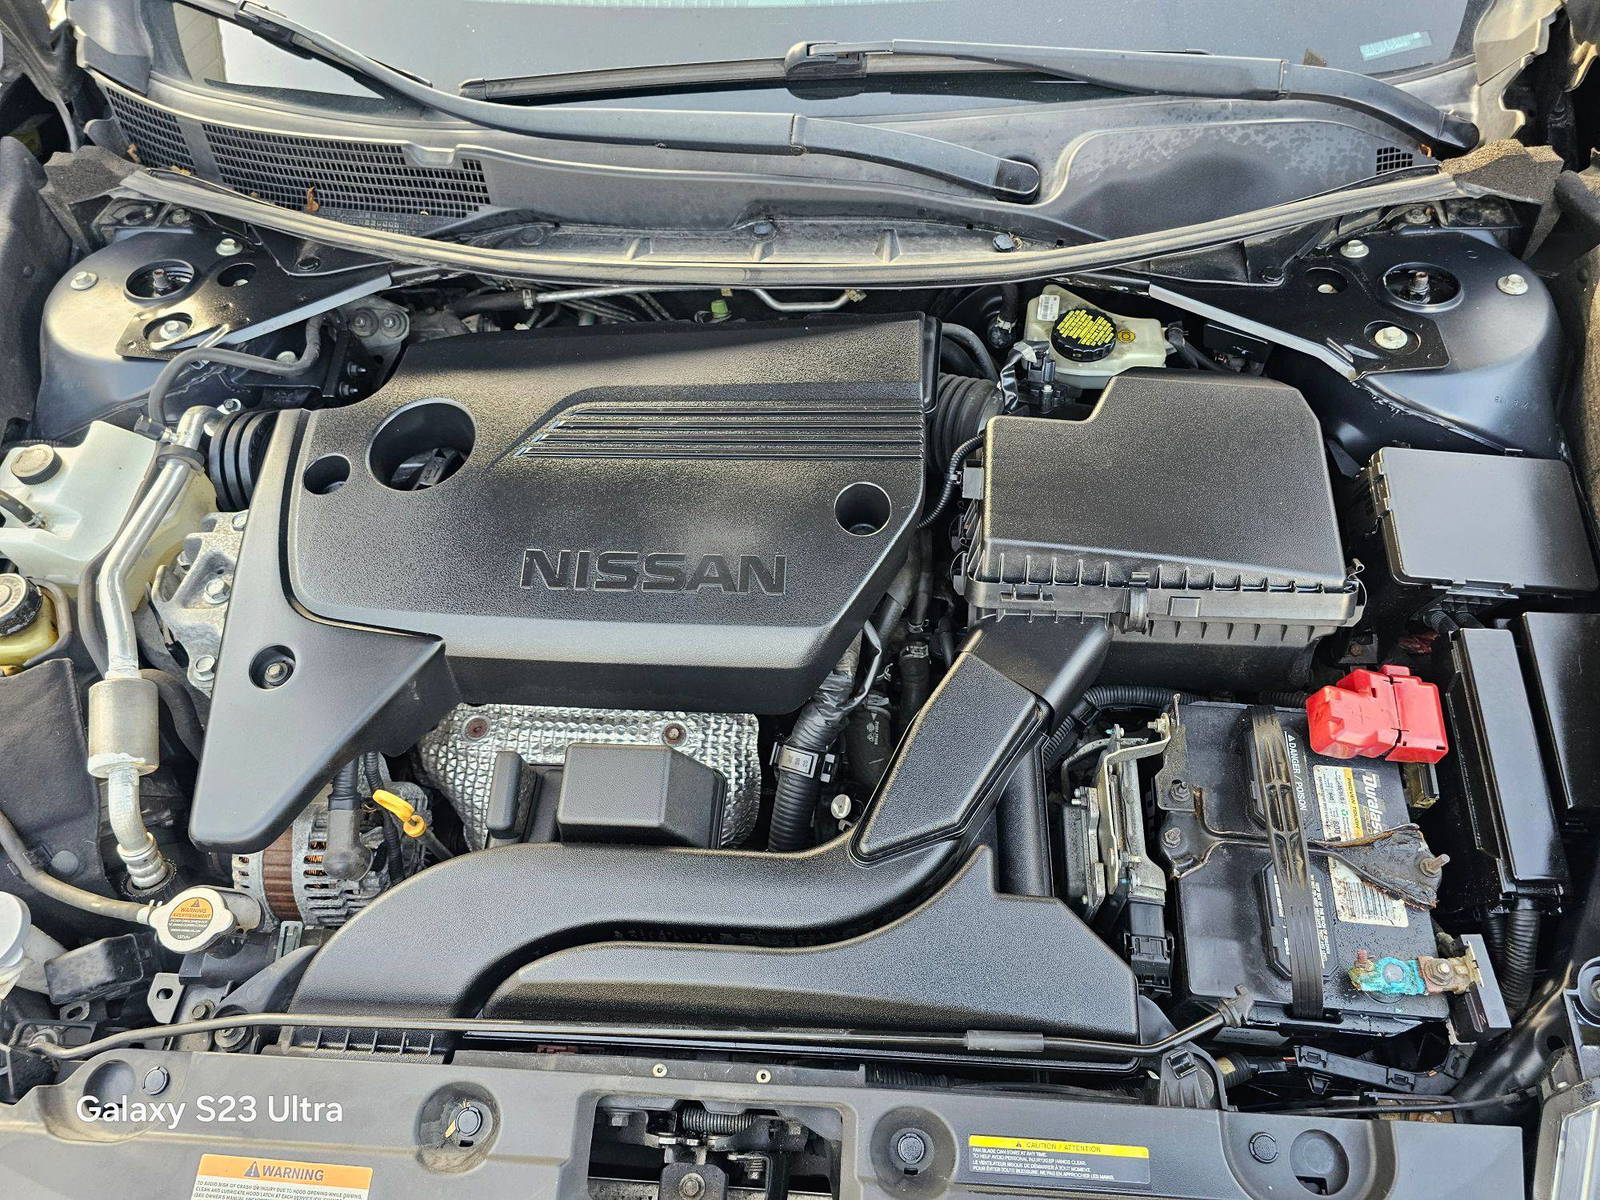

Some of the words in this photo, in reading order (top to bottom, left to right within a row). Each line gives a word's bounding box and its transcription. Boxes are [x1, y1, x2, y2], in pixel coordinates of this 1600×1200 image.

[520, 548, 787, 596] NISSAN
[1289, 743, 1300, 774] DANGER
[1295, 782, 1307, 811] POISON
[1347, 777, 1356, 804] PROVEN
[1352, 806, 1361, 830] TOUGH
[1026, 1142, 1056, 1150] CAUTION
[1064, 1144, 1101, 1152] ATTENTION
[262, 1164, 325, 1182] WARNING
